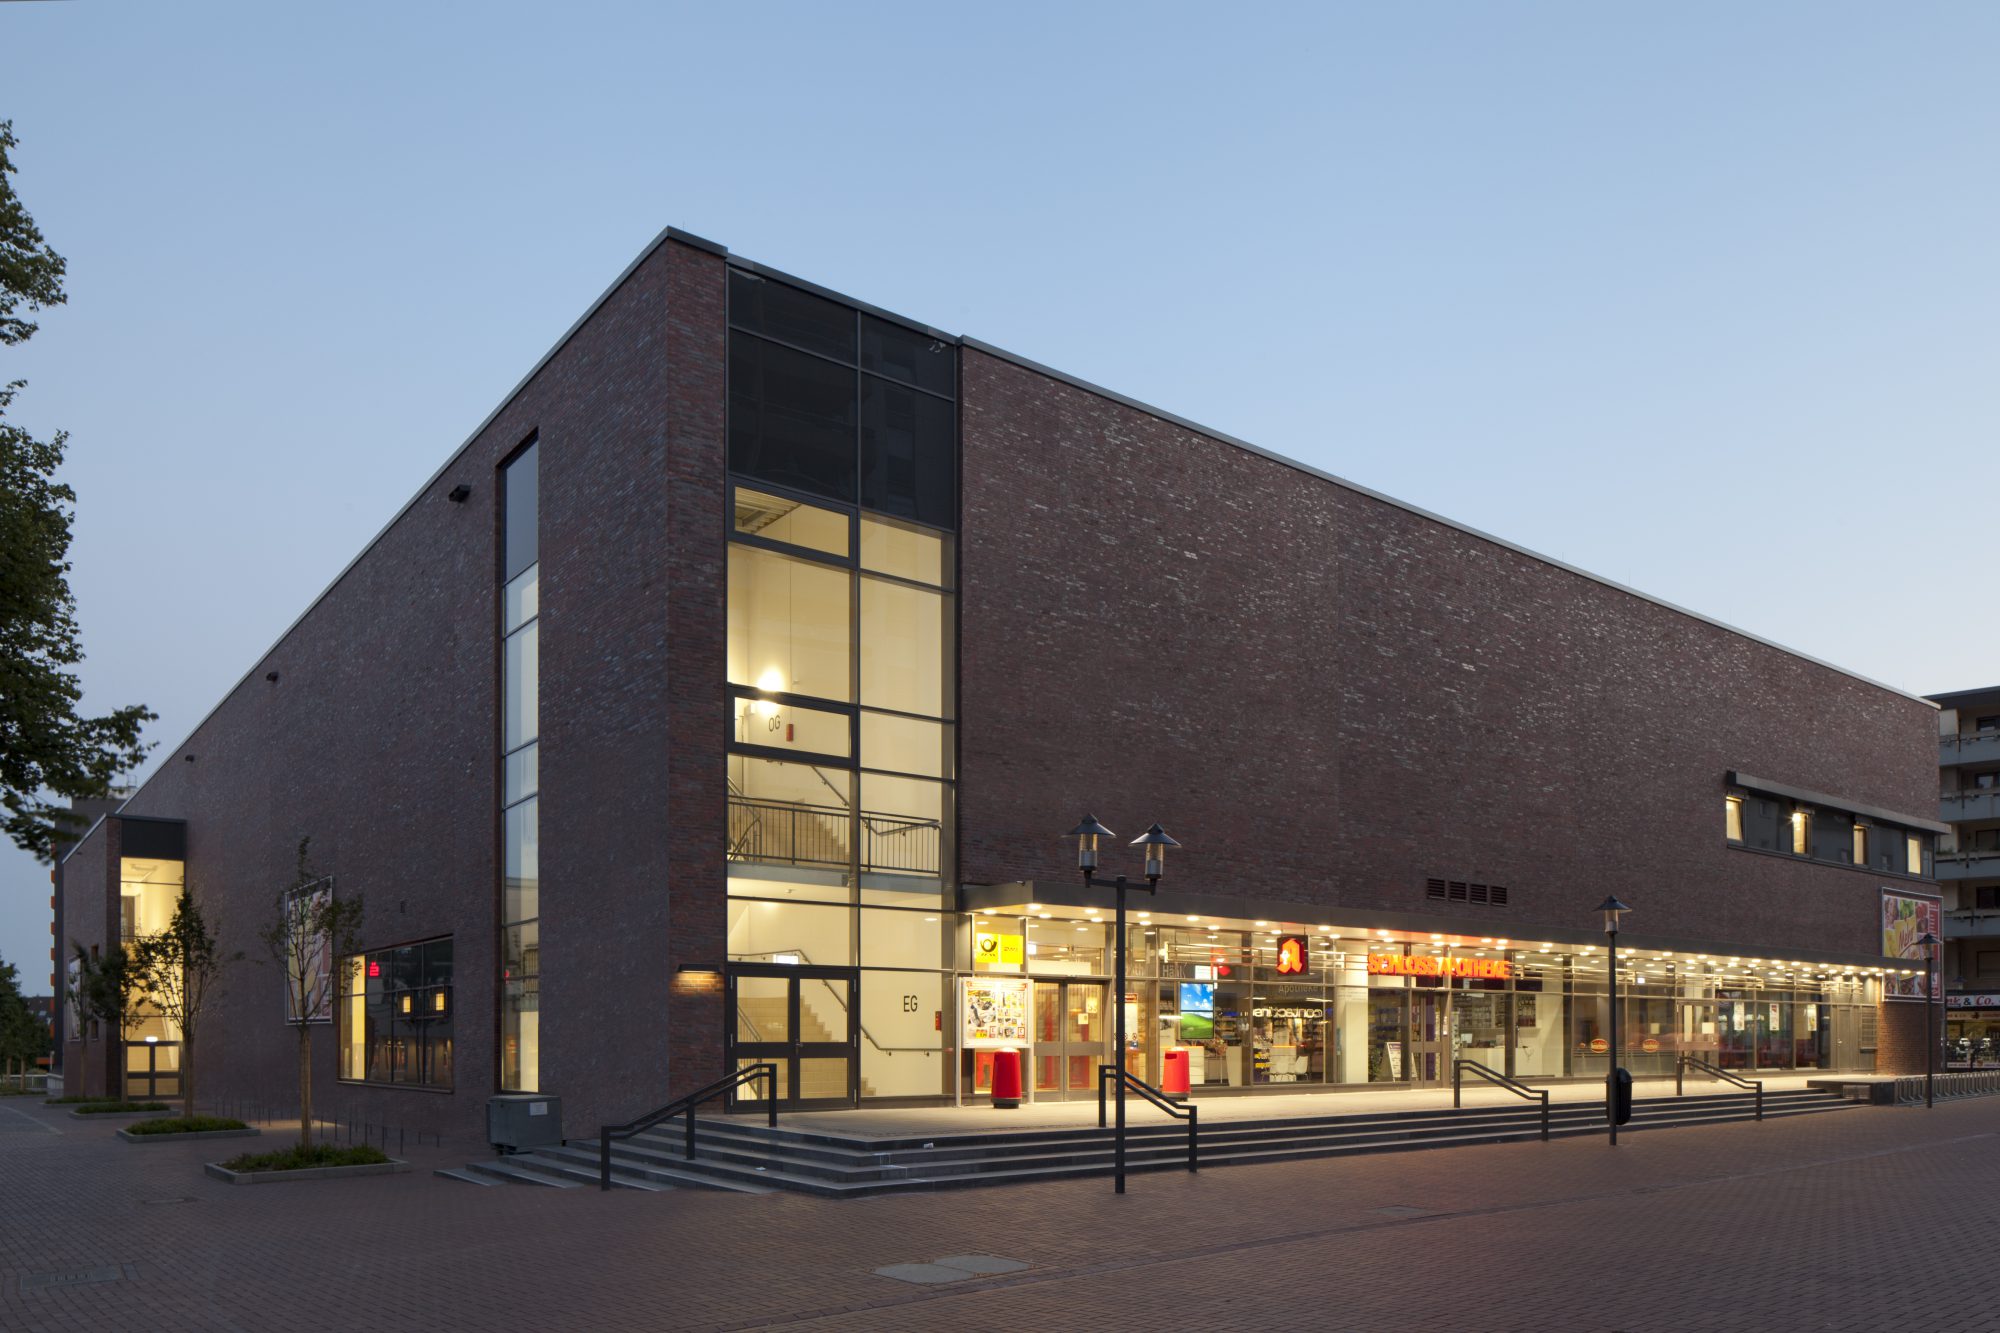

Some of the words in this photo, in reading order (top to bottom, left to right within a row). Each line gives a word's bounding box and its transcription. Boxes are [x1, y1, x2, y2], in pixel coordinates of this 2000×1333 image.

[768, 715, 781, 732] OG
[1368, 953, 1438, 976] SCHLOSS
[1439, 957, 1510, 979] APOTHEKE
[904, 995, 918, 1012] EG
[1976, 995, 1994, 1006] Co.
